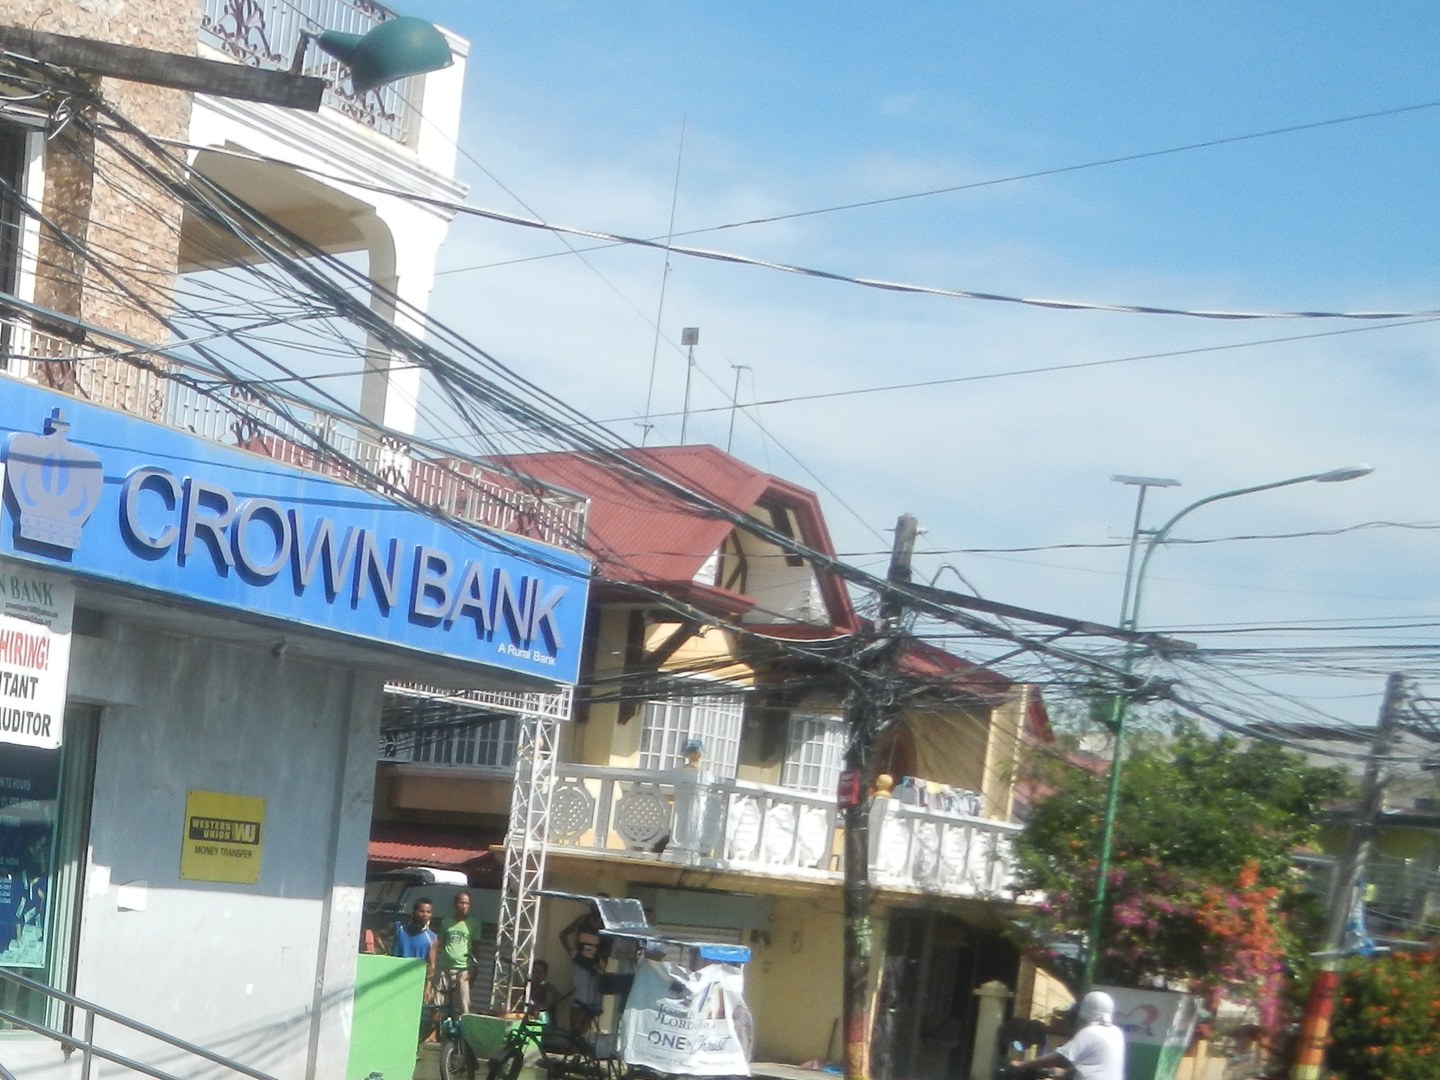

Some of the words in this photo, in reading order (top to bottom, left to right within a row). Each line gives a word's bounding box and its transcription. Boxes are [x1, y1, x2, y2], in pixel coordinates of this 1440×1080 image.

[120, 466, 403, 609] CROWN
[409, 545, 570, 652] BANK
[10, 575, 54, 607] BANK
[498, 642, 506, 653] A
[508, 644, 531, 660] Rural
[533, 651, 556, 666] Bank
[192, 819, 231, 831] WESTERN
[203, 830, 231, 840] UNION
[194, 845, 219, 857] MONEY
[221, 847, 253, 859] TRANSFER
[647, 1030, 687, 1050] ONE
